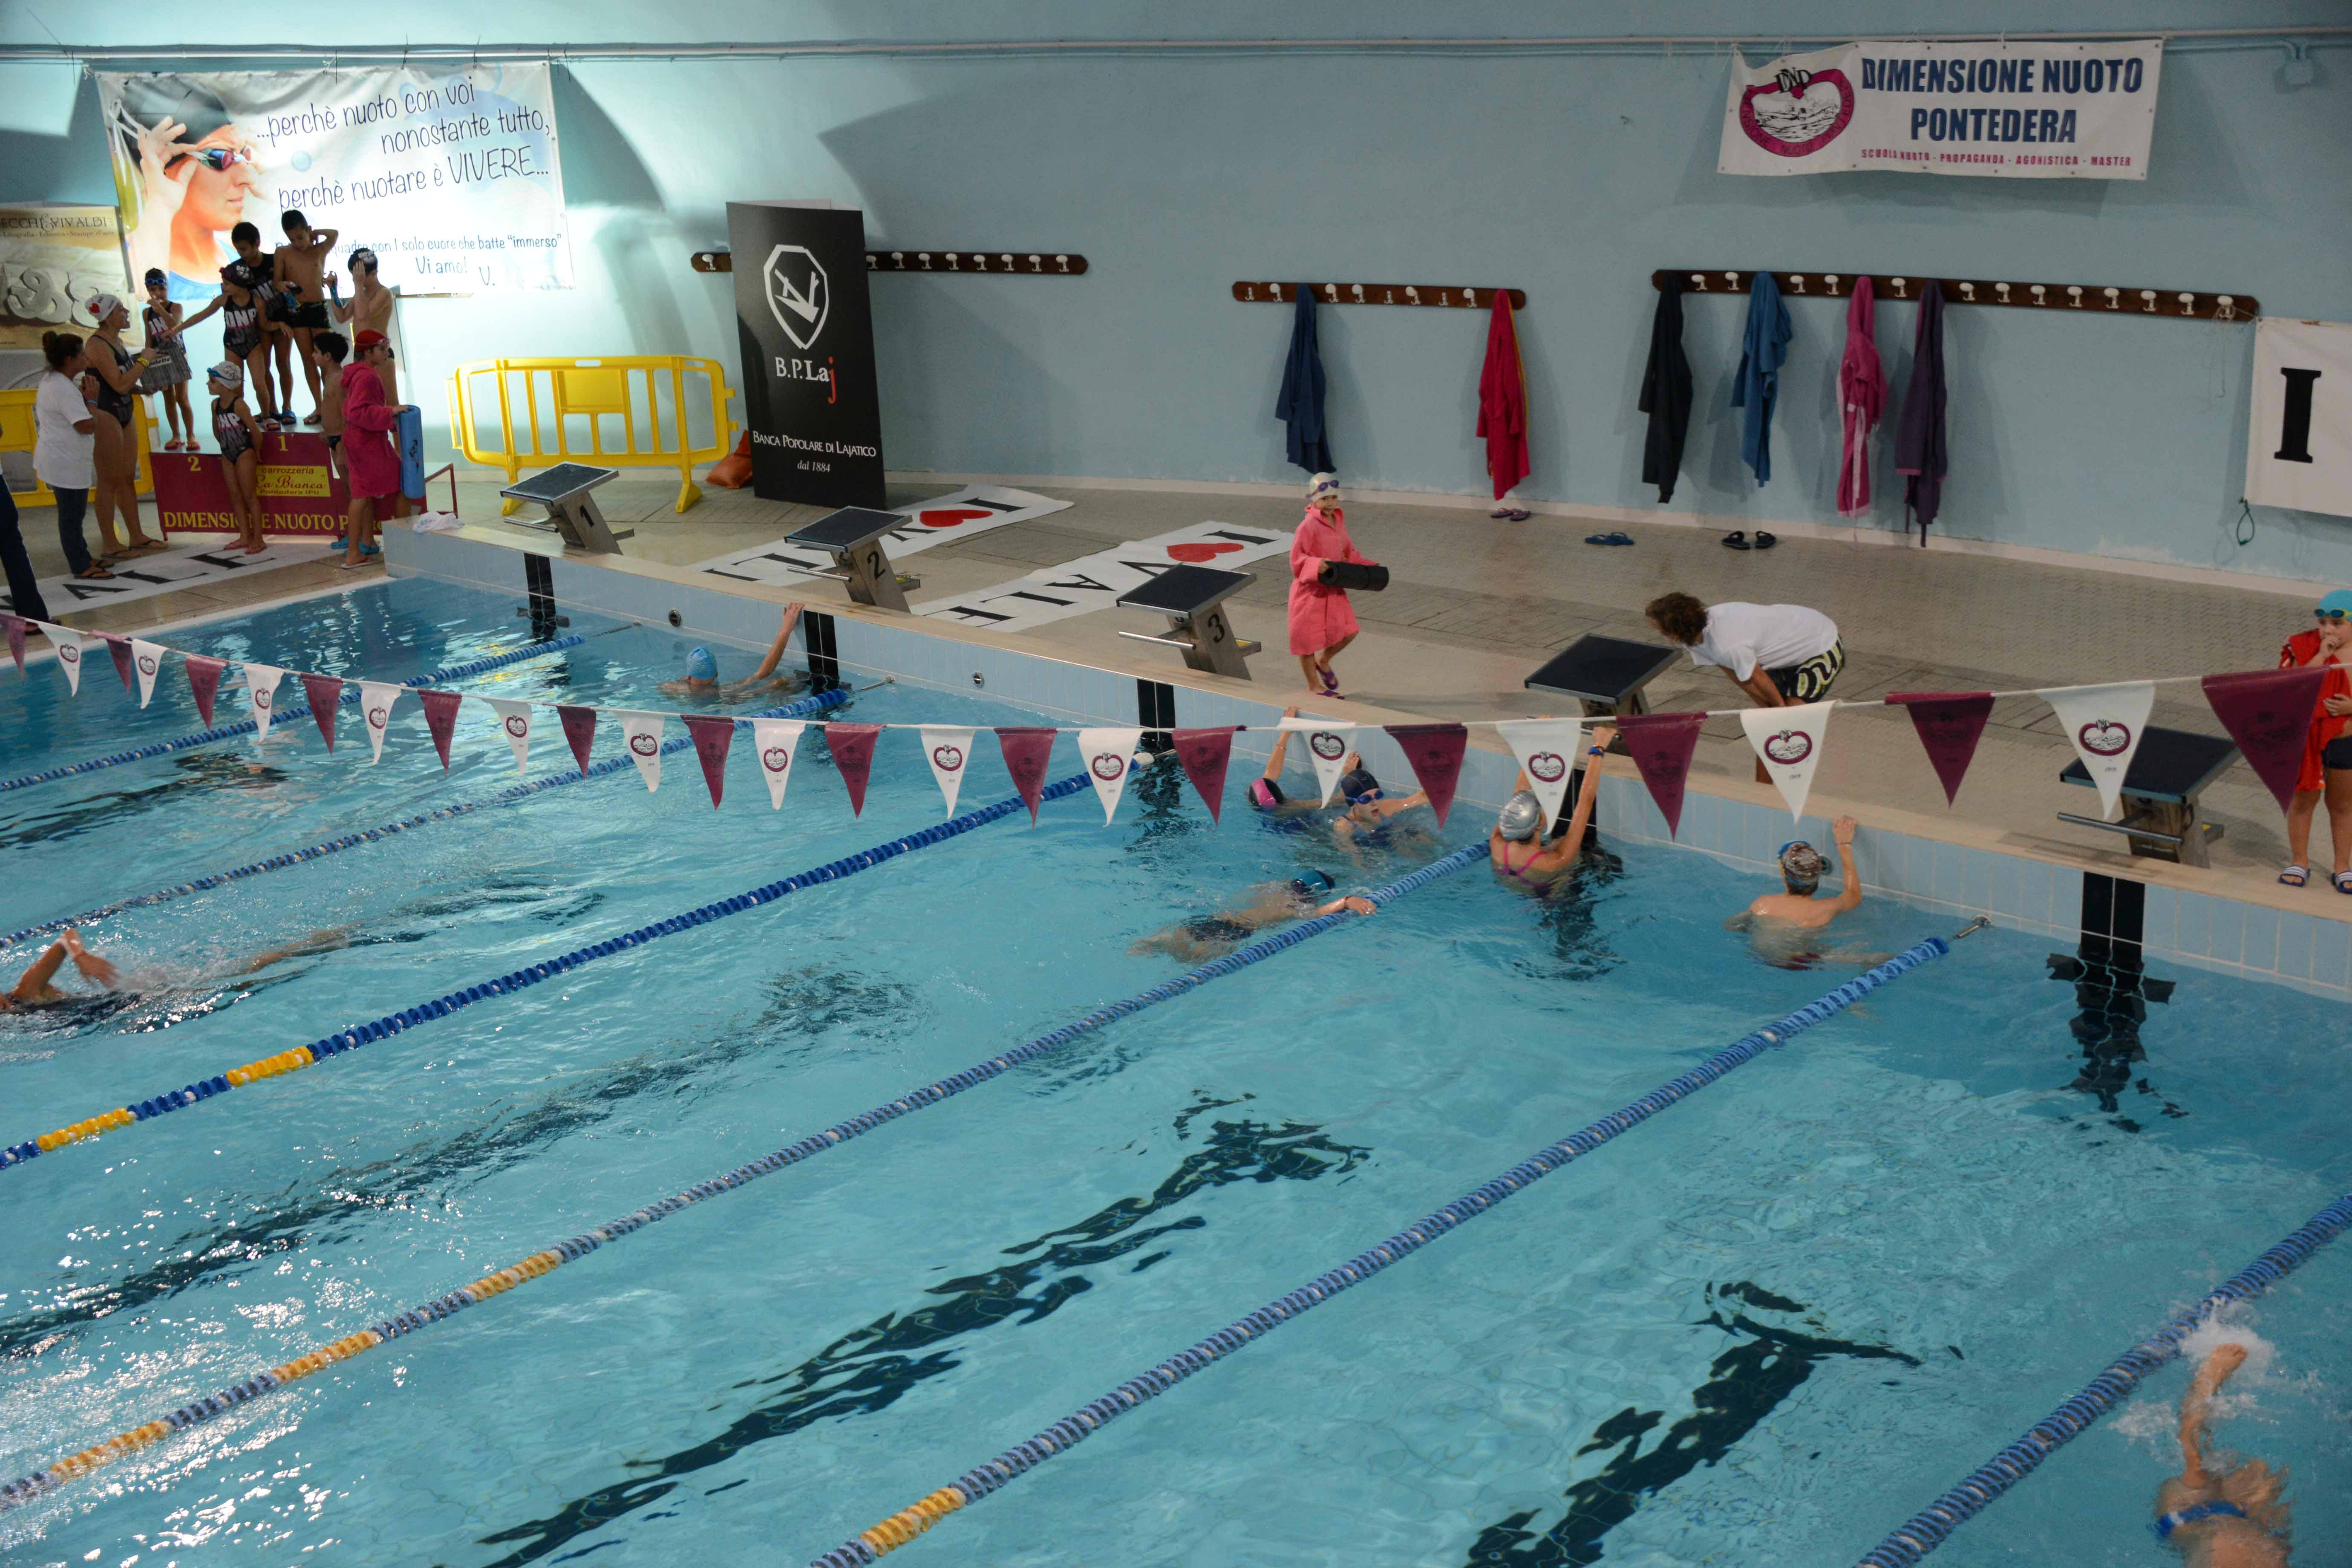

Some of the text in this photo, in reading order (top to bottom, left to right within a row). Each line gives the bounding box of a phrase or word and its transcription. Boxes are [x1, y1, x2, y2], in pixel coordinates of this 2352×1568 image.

[1862, 58, 2143, 93] DIMENSIONE NUOTO
[257, 76, 476, 147] ...perchè nuoto con voi
[381, 106, 550, 154] nonostante tutto,
[1911, 108, 2076, 143] PONTEDERA
[1861, 149, 1897, 159] SCUOLA
[1900, 151, 1929, 161] NUOTO
[1940, 153, 2004, 164] PROPAGANDA
[2016, 155, 2078, 165] AGONISTICA
[2090, 156, 2131, 166] MASTER
[278, 145, 549, 213] perchè nuotare è VIVERE...
[372, 241, 392, 253] con
[402, 236, 424, 250] solo
[428, 238, 455, 249] cuore
[458, 236, 476, 249] che
[478, 235, 505, 249] batte
[478, 265, 496, 285] V.
[2274, 367, 2322, 463] I
[278, 435, 288, 451] 1
[187, 456, 201, 471] 2
[798, 460, 830, 473] dal 1884
[274, 515, 334, 530] NUOTO
[579, 505, 594, 527] 1
[867, 551, 886, 579] 2
[1208, 613, 1225, 643] 3
